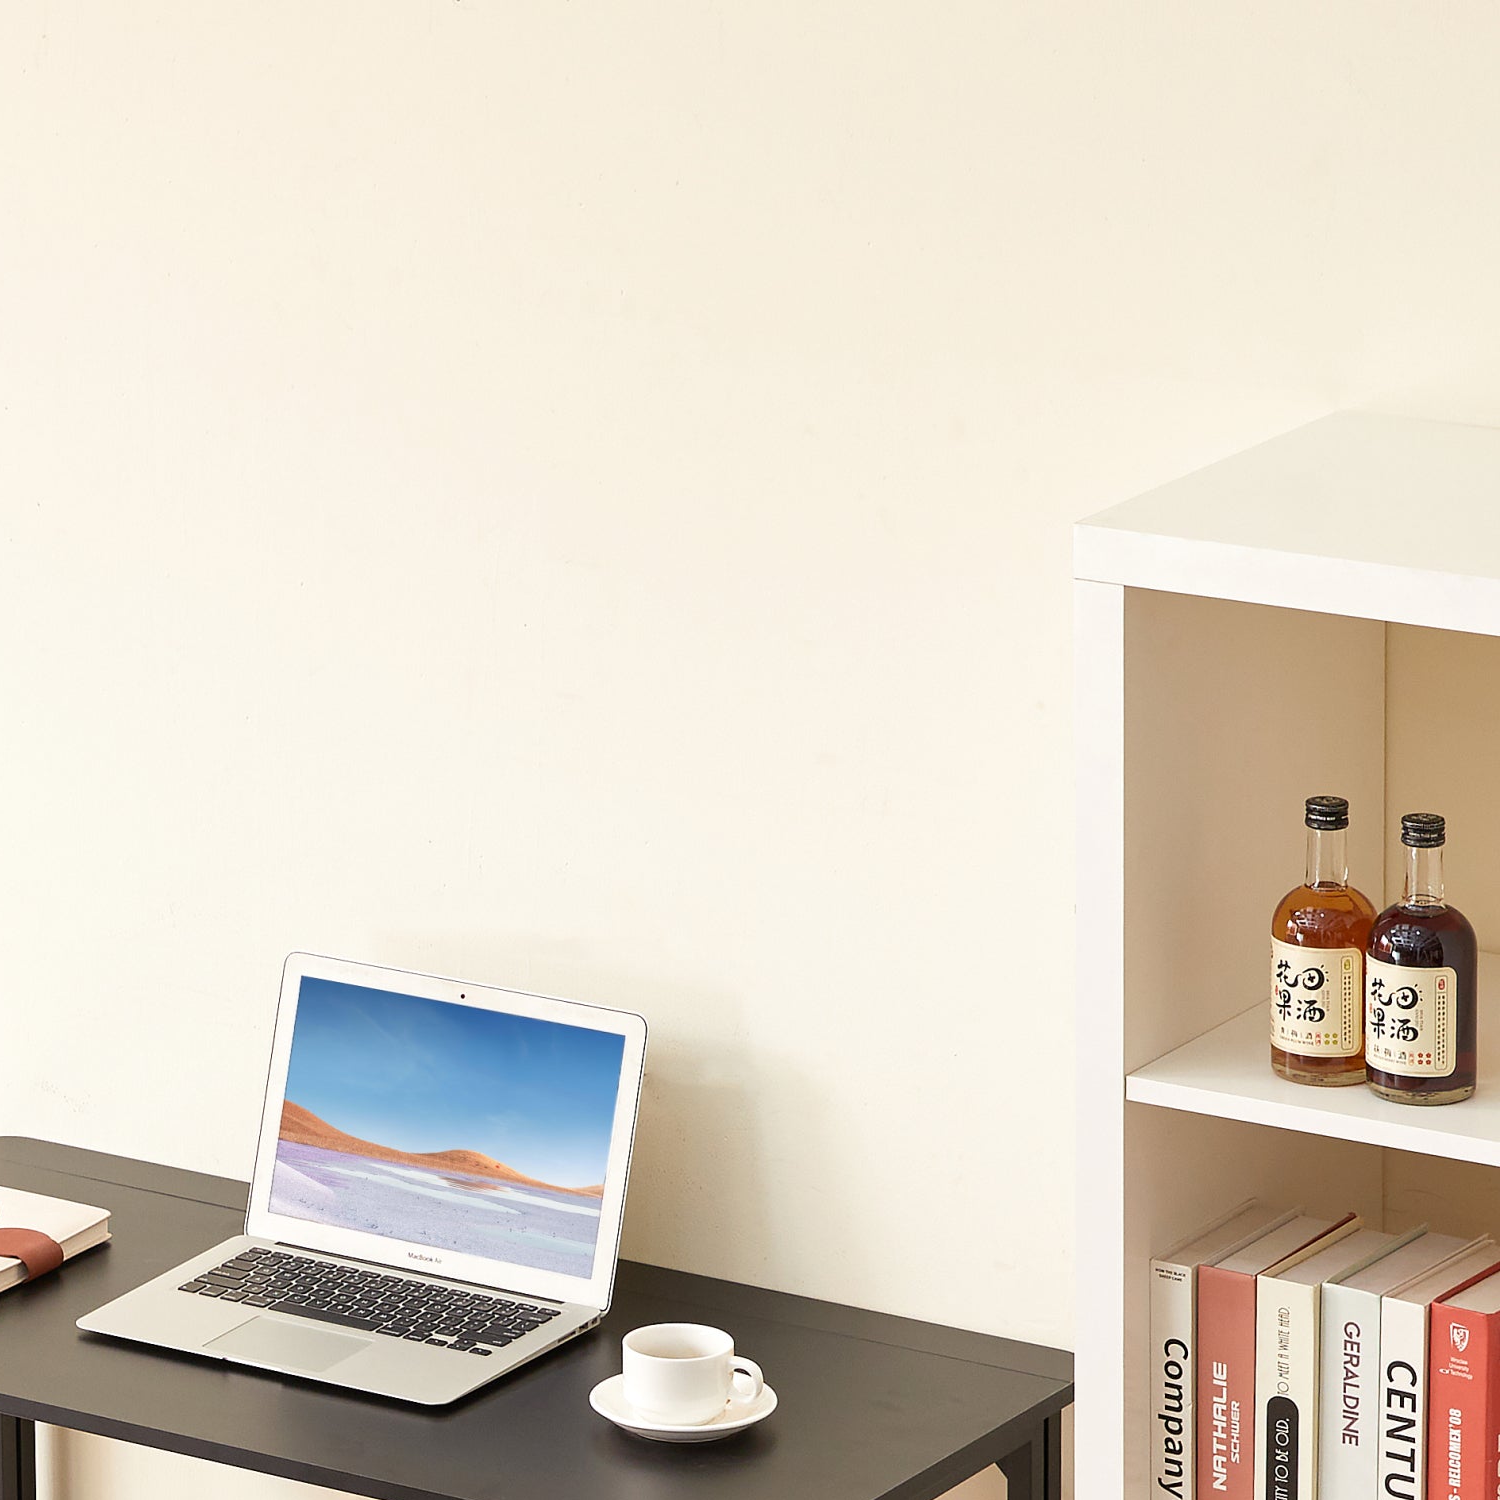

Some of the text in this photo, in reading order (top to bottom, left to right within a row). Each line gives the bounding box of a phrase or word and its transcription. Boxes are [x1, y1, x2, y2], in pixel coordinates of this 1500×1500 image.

[408, 1252, 433, 1262] MacBook
[1341, 1321, 1361, 1447] GERALDINE
[1157, 1338, 1189, 1500] Company
[1212, 1361, 1228, 1492] NATHALIE
[1231, 1400, 1241, 1464] SCHWER
[1275, 1418, 1290, 1447] OLD.
[1275, 1448, 1289, 1463] BE
[1275, 1464, 1289, 1483] TO
